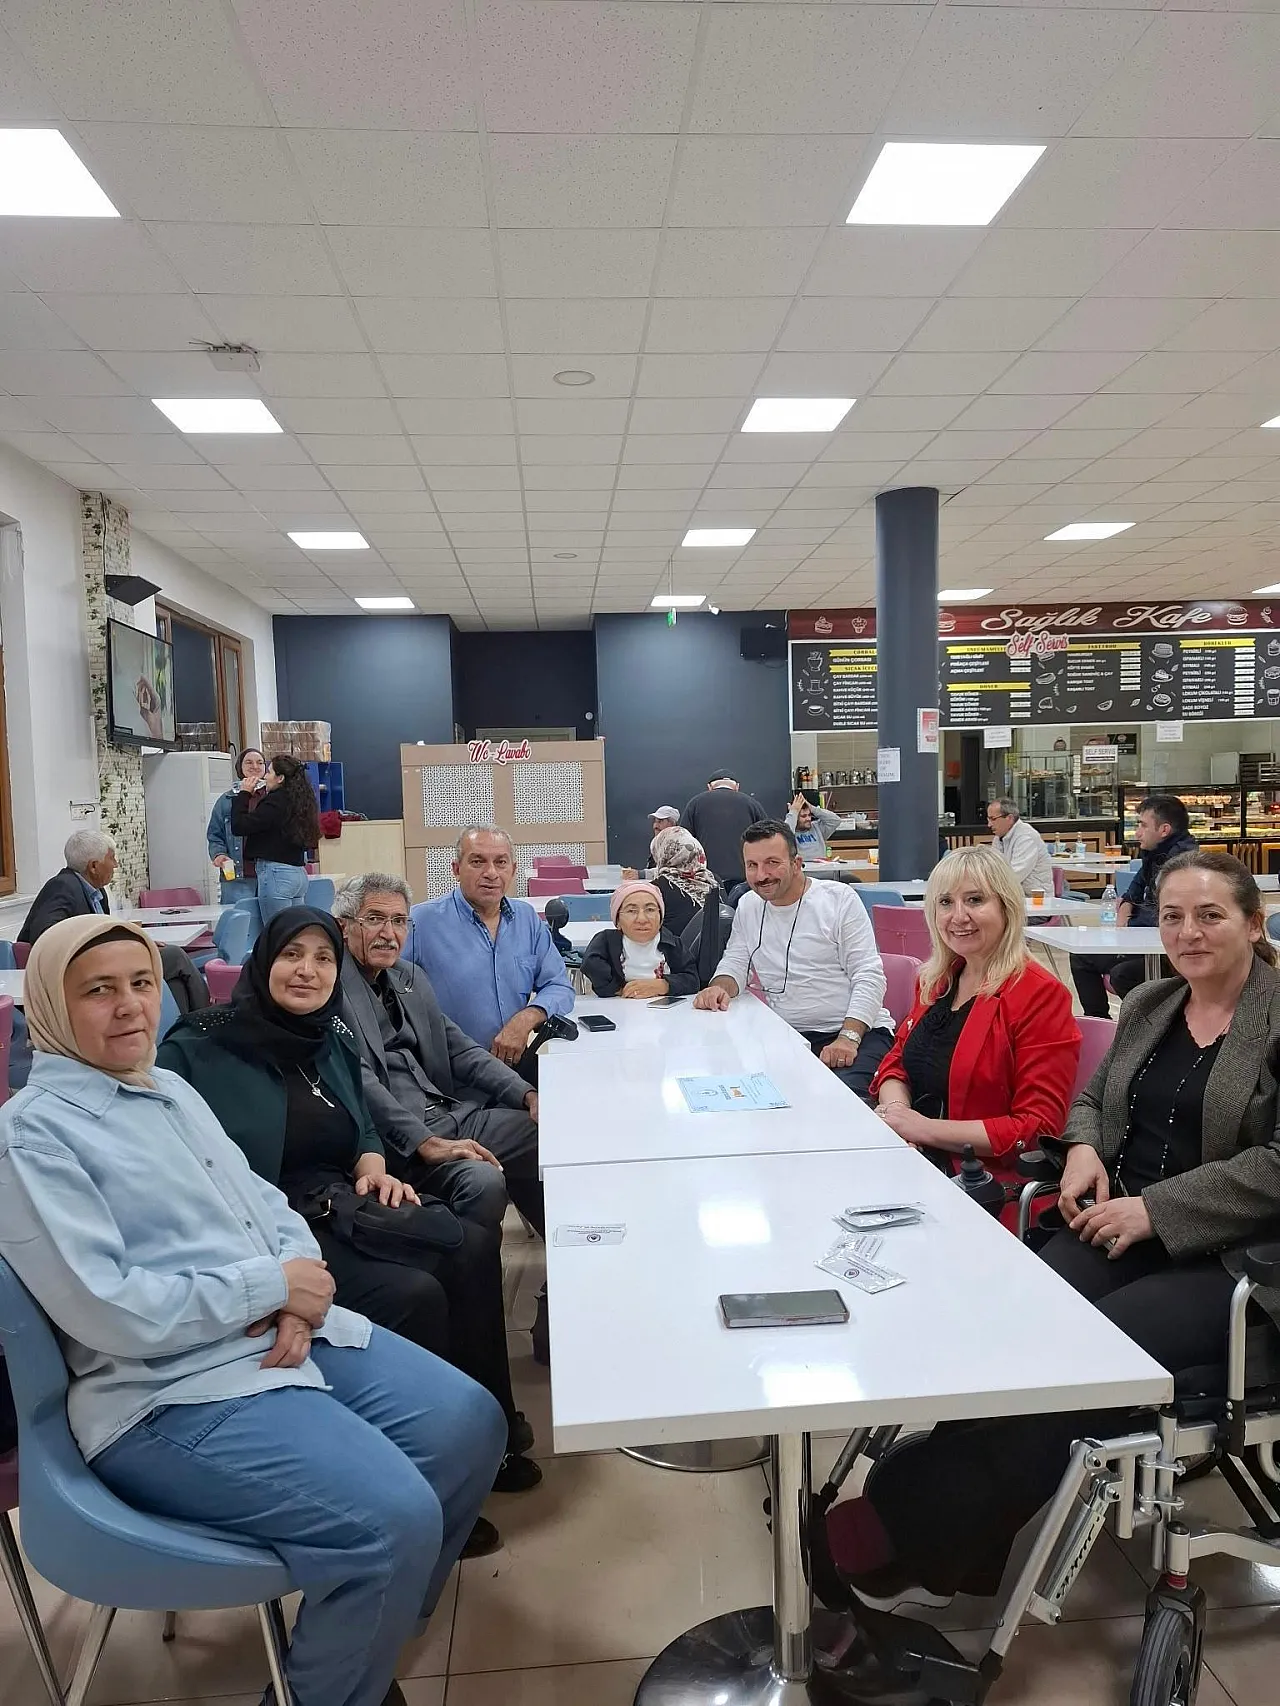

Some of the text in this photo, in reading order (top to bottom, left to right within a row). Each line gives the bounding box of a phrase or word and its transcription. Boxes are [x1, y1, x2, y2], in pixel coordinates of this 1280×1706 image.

[980, 606, 1213, 632] Sağlık Kafe
[1007, 632, 1068, 657] Self Servis
